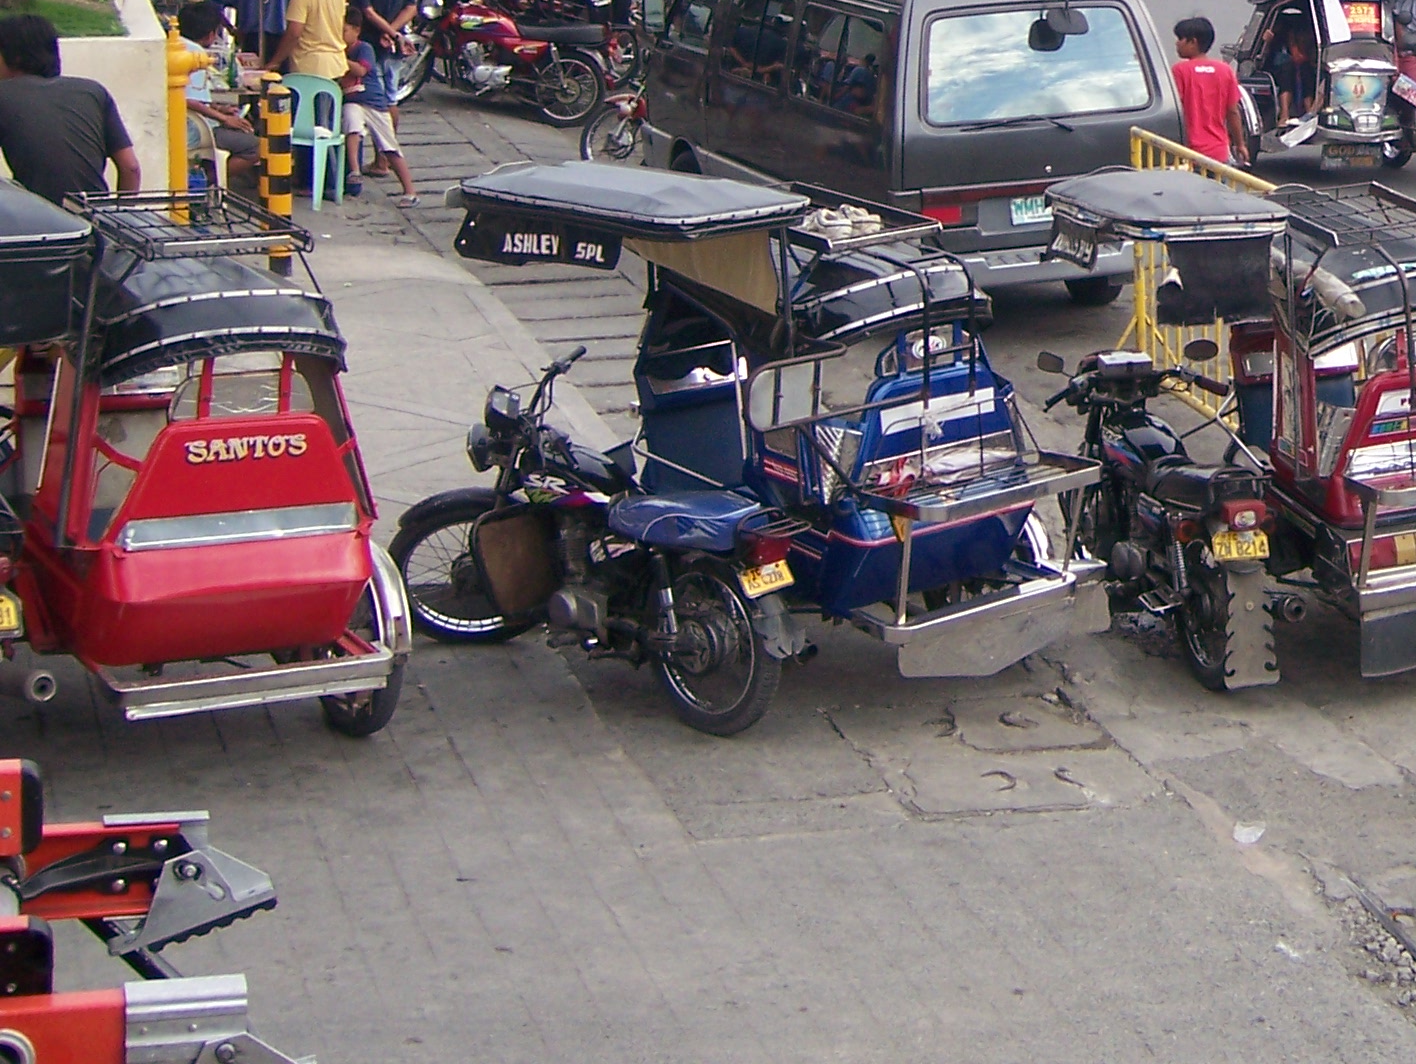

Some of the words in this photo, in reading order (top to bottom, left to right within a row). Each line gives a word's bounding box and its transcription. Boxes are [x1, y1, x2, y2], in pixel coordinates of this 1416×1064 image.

[502, 233, 560, 255] ASHLEY
[574, 241, 605, 263] SPL
[185, 433, 308, 464] SANTOS
[524, 473, 571, 496] SR
